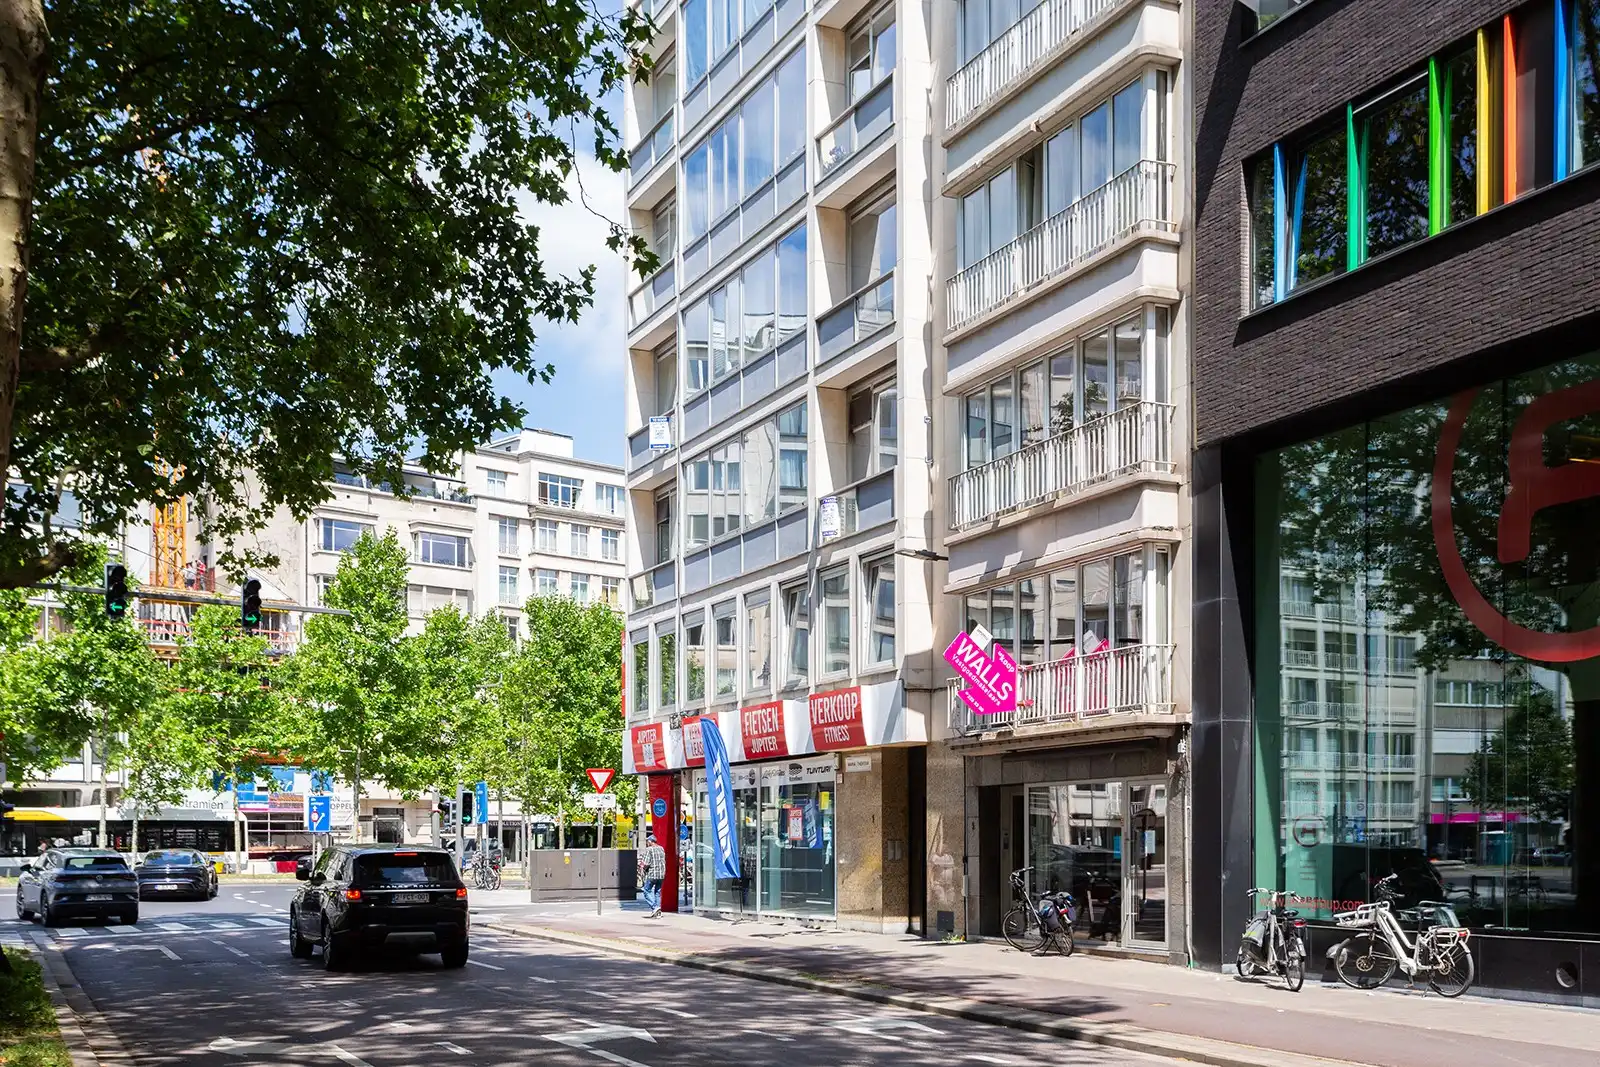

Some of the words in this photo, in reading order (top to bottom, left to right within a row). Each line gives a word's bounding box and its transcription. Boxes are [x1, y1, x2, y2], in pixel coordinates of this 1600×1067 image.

[957, 637, 1013, 701] WALLS
[810, 692, 858, 725] VERKOOP
[744, 707, 779, 736] FIETSEN
[637, 729, 657, 744] JUPITER
[823, 725, 850, 744] FITNESS
[751, 735, 779, 754] JUPITER
[805, 765, 833, 775] TUNTURI
